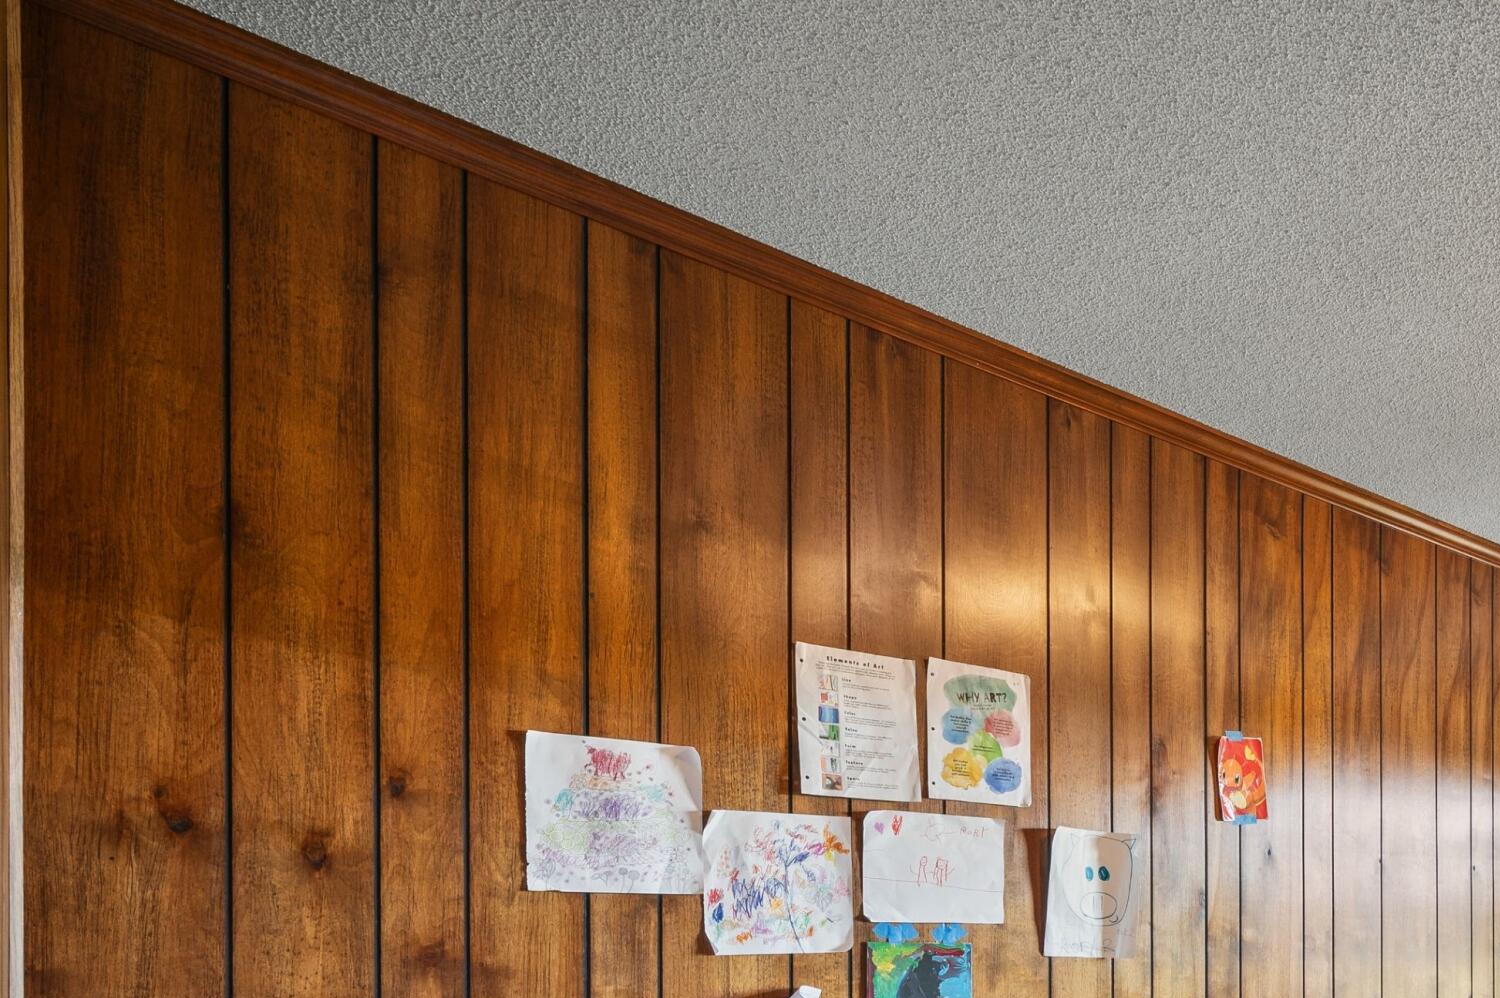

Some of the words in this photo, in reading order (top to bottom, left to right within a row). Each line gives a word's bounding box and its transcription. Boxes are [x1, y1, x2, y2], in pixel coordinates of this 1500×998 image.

[827, 656, 859, 666] Elements
[956, 692, 979, 703] WHY
[984, 692, 1007, 703] ART?
